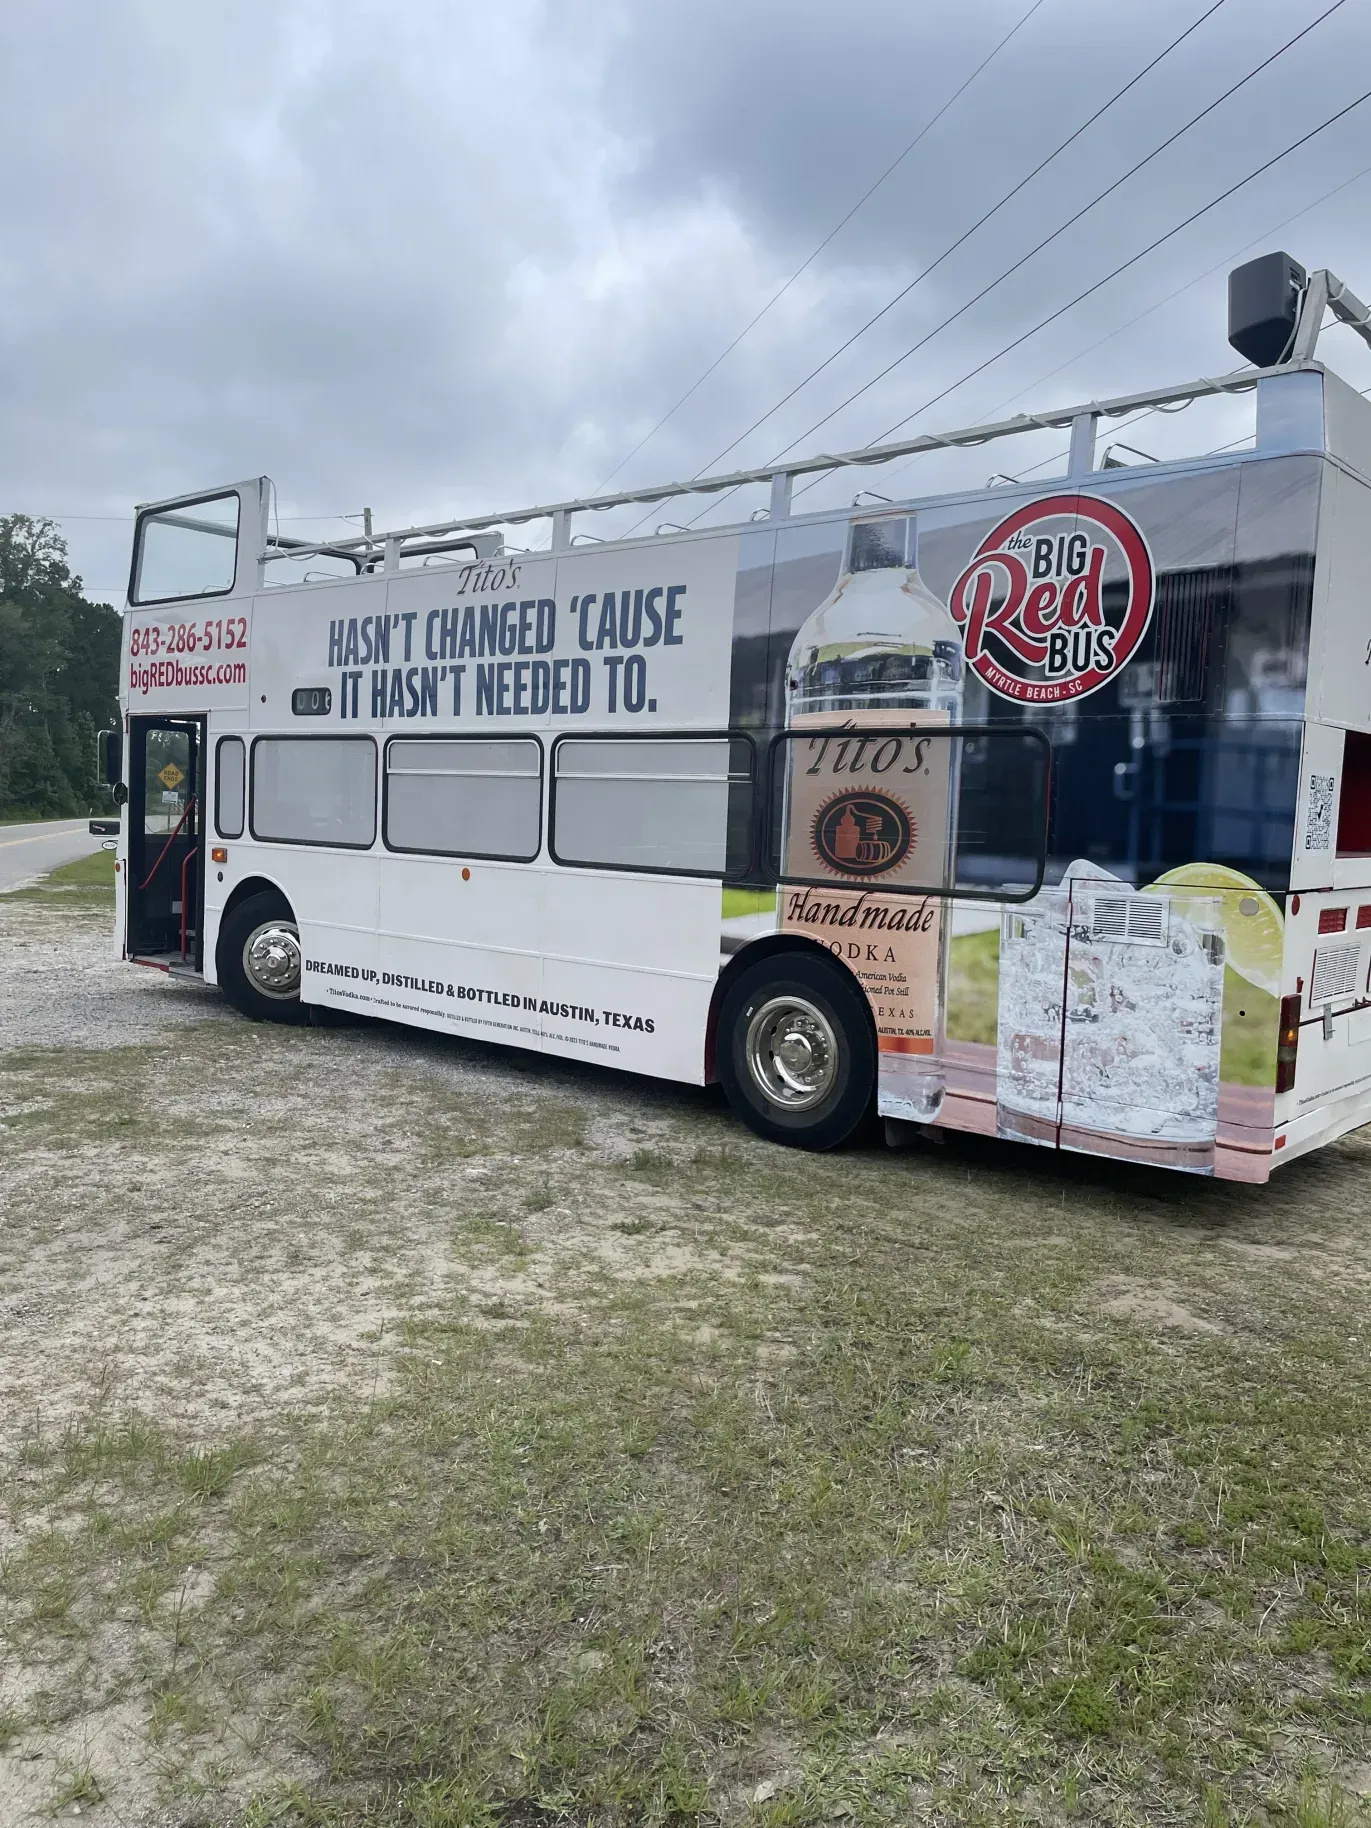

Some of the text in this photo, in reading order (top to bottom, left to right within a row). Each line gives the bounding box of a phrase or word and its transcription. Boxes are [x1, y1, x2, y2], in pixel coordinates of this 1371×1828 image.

[1008, 531, 1088, 578] the BIG
[457, 559, 521, 594] Tito's
[951, 548, 1104, 663] Red
[131, 617, 247, 656] 843-286-5152
[329, 585, 686, 667] HASN'T CHANGED 'CAUSE
[1048, 630, 1115, 672] BUS
[131, 660, 246, 695] bigREDbussc.com
[341, 654, 657, 719] IT HASN'T NEEDED TO.
[985, 667, 1022, 695] MYRTLE
[1026, 687, 1060, 698] BEACH
[1068, 680, 1082, 694] SC
[787, 886, 935, 932] Handmade
[814, 940, 896, 962] ODKA
[856, 970, 906, 982] American Vodka
[884, 986, 894, 995] Pot
[896, 986, 910, 996] Still
[306, 960, 655, 1033] DREAMED UP, DISTILLED & BOTTLED IN AUSTIN, TEXAS
[871, 1006, 914, 1018] EXAS
